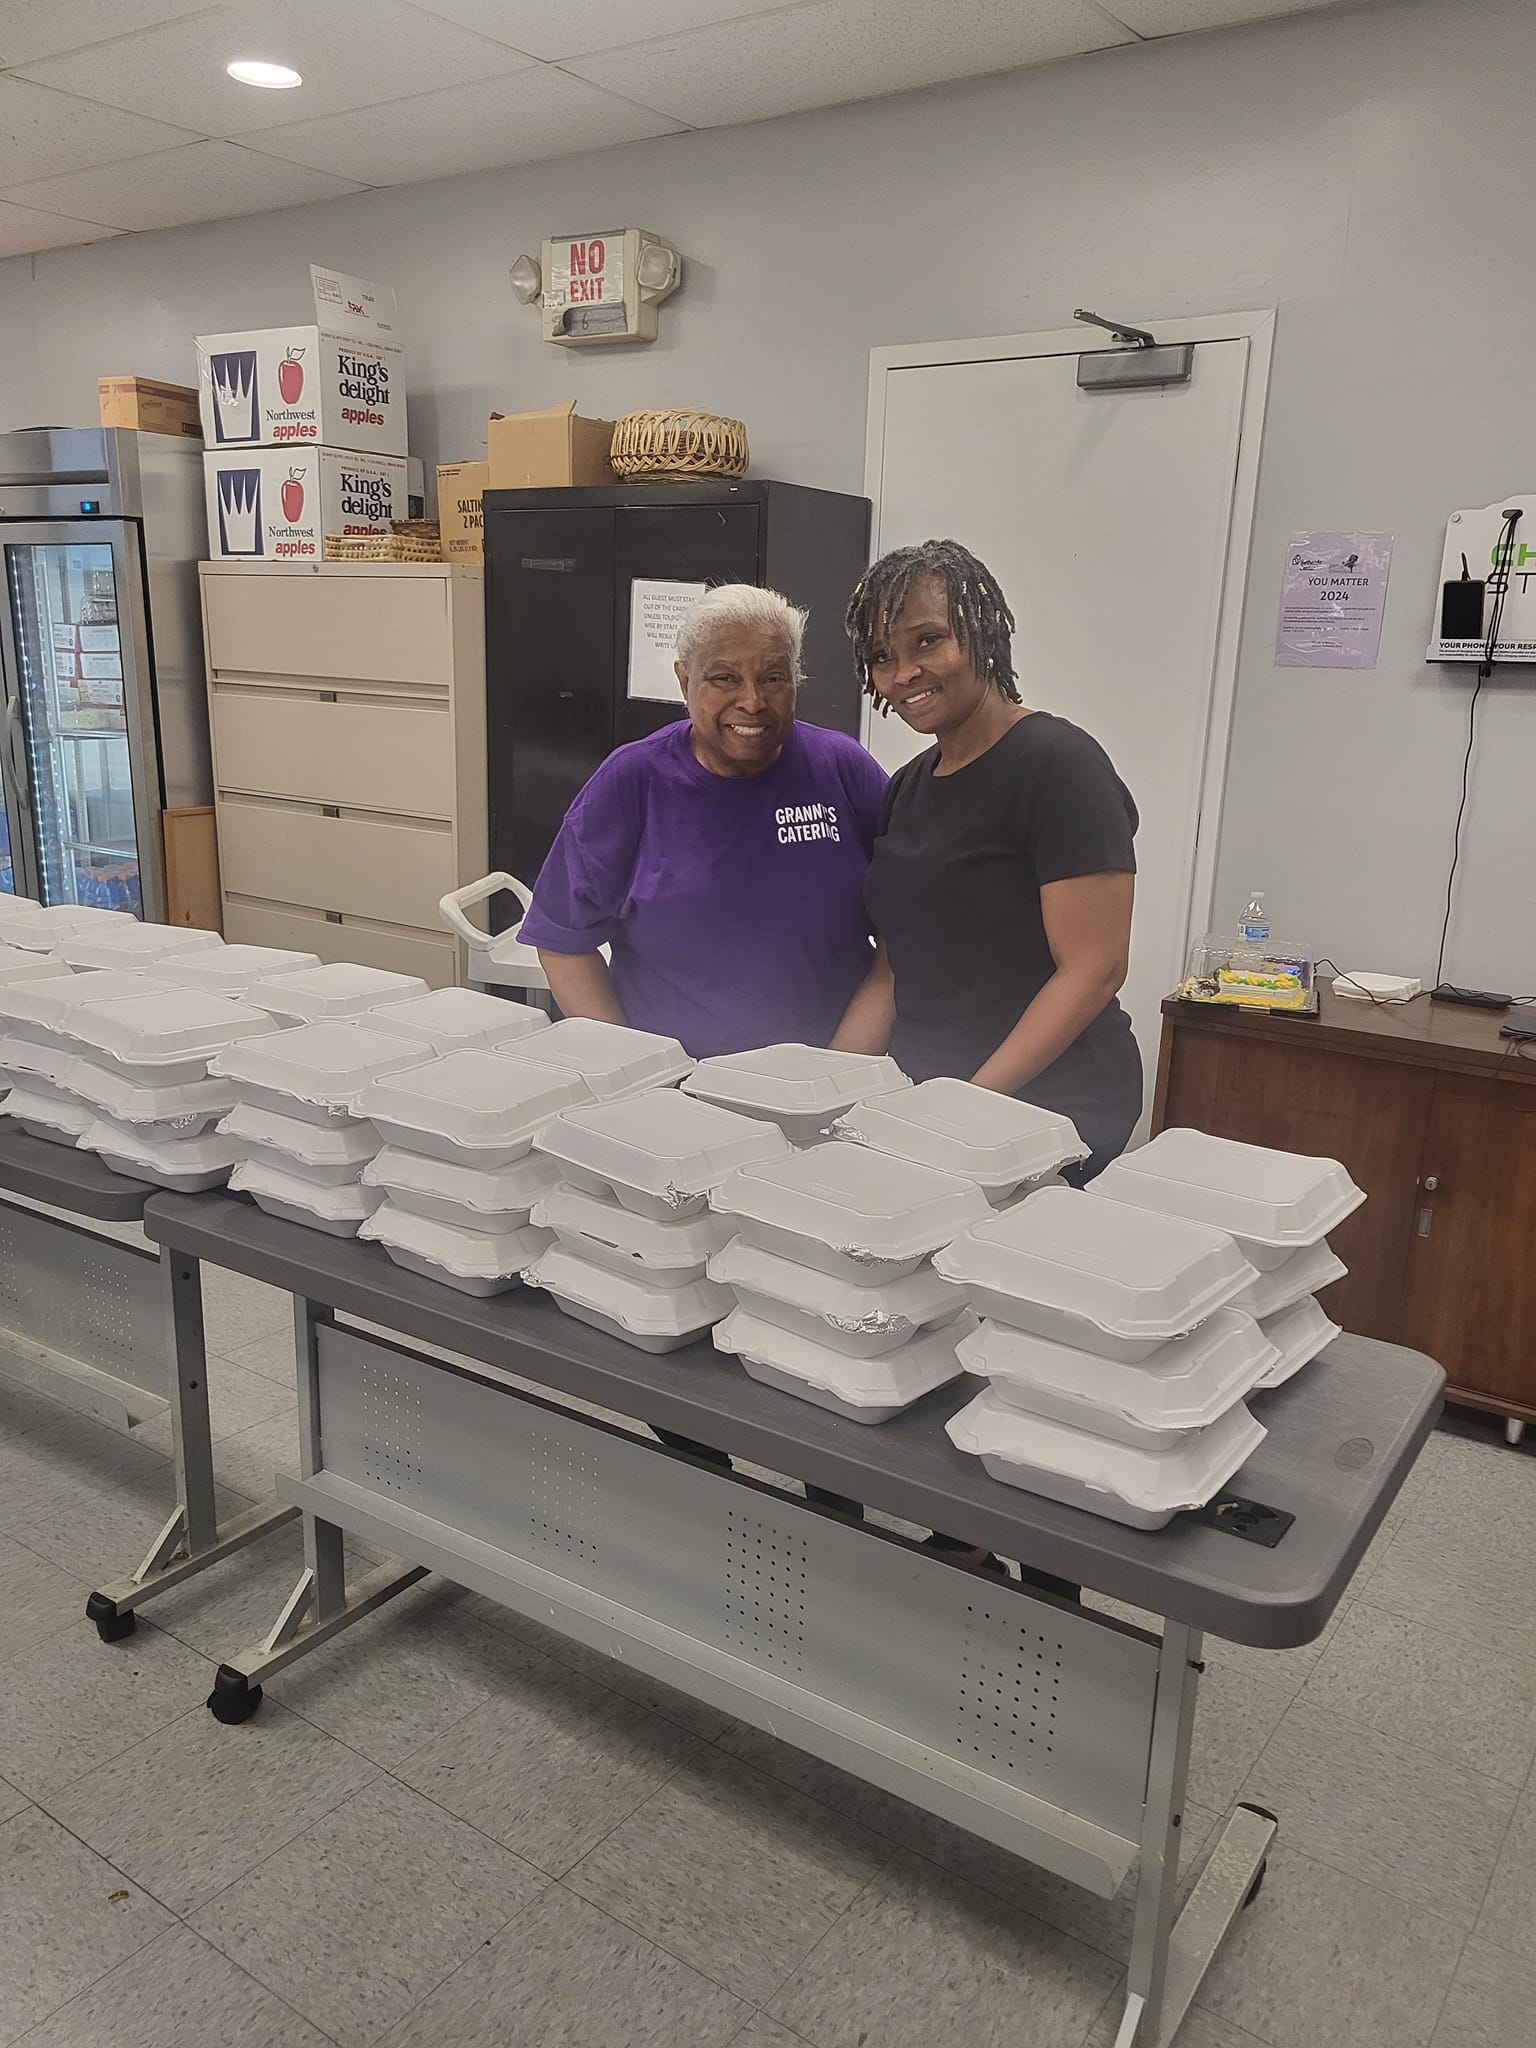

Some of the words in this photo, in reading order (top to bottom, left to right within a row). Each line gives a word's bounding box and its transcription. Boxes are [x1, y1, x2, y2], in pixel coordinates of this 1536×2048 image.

[570, 240, 605, 276] NO
[570, 278, 604, 302] EXIT
[337, 354, 389, 386] King's
[339, 379, 390, 406] delight
[266, 409, 316, 422] Northwest
[341, 407, 384, 426] apples
[272, 422, 318, 440] apples
[340, 473, 392, 501] King's
[342, 496, 392, 521] delight
[464, 516, 468, 528] 2
[269, 526, 314, 537] Northwest
[275, 540, 316, 557] apples
[1308, 578, 1328, 586] YOU
[1330, 578, 1369, 586] MATTER
[1320, 591, 1350, 601] 2024
